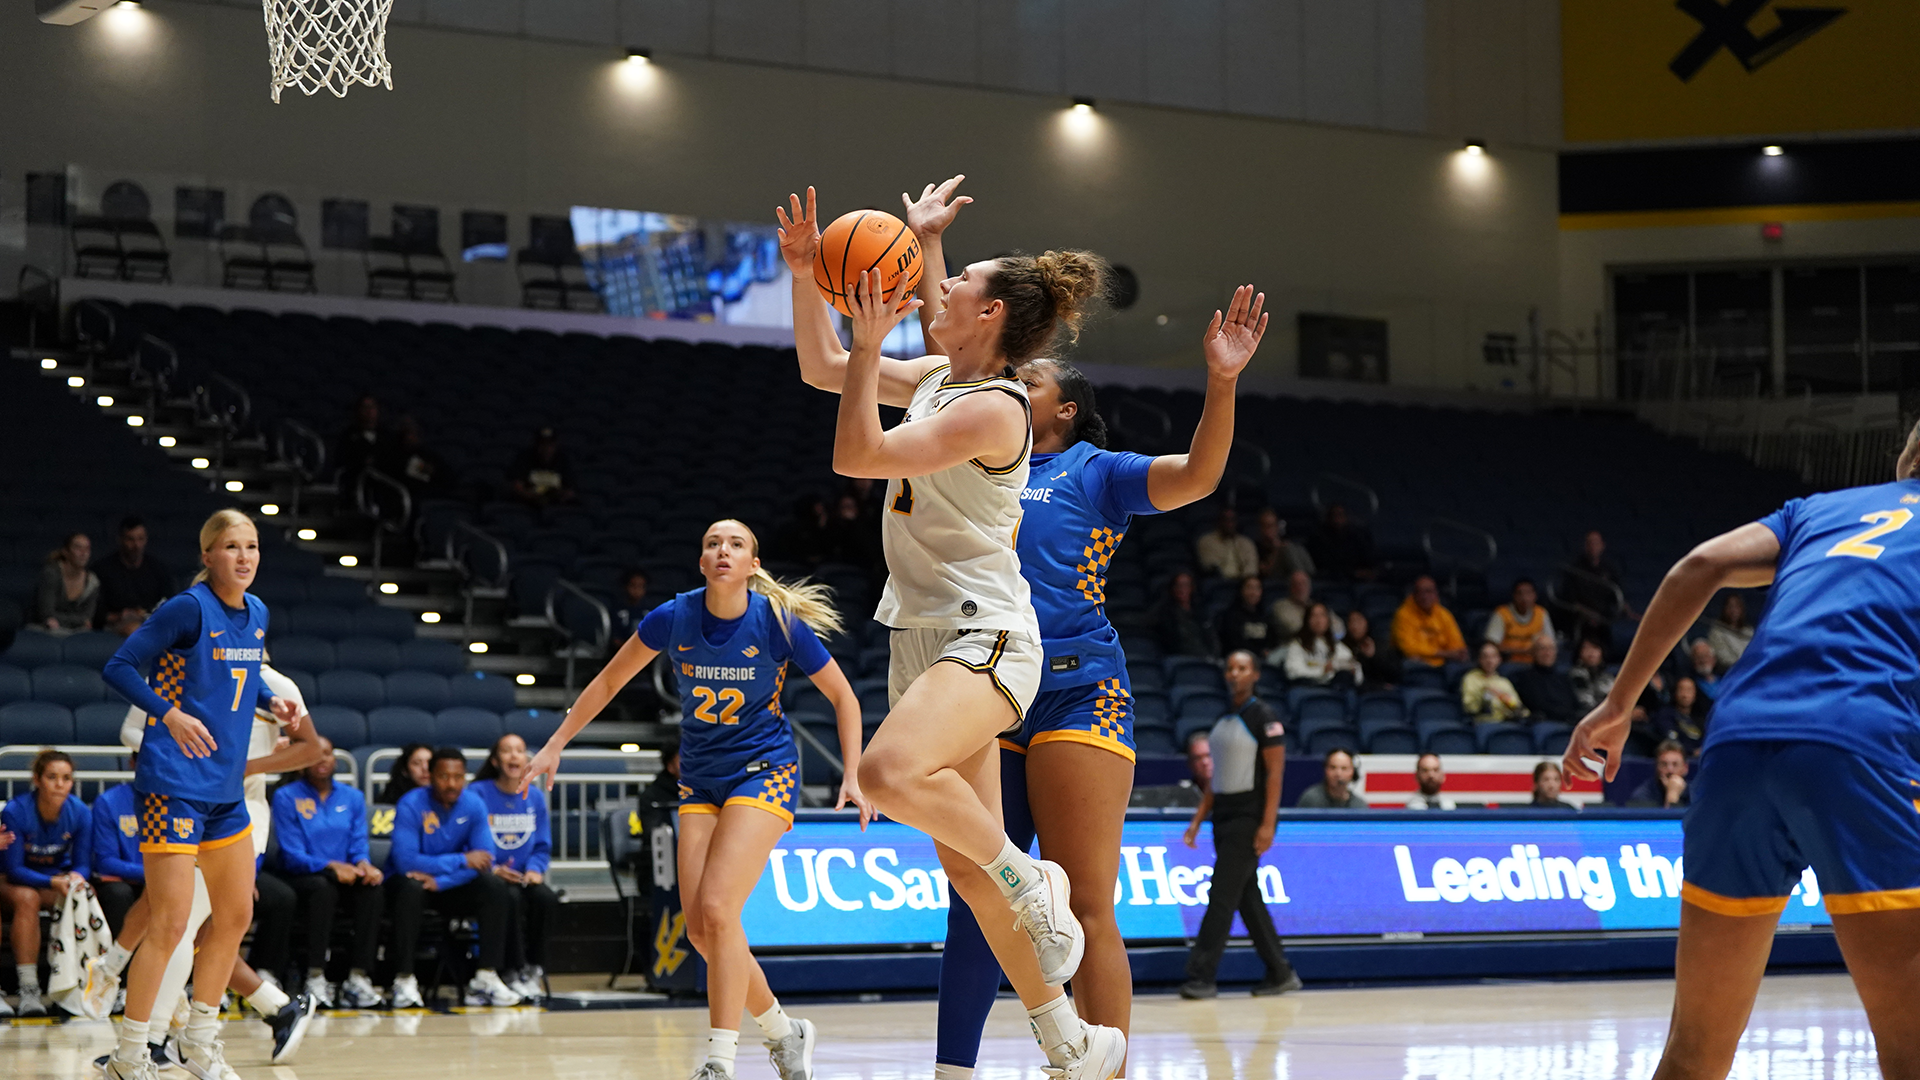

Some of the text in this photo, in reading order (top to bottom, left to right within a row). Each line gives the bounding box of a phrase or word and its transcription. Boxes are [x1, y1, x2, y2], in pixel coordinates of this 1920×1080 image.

[896, 238, 920, 273] EVO
[1825, 507, 1914, 560] 2
[212, 647, 261, 661] UC RIVERSIDE
[681, 662, 756, 681] UC RIVERSIDE
[231, 668, 248, 712] 7
[692, 685, 745, 725] 22
[769, 848, 864, 912] UC
[1393, 843, 1684, 911] Leading th
